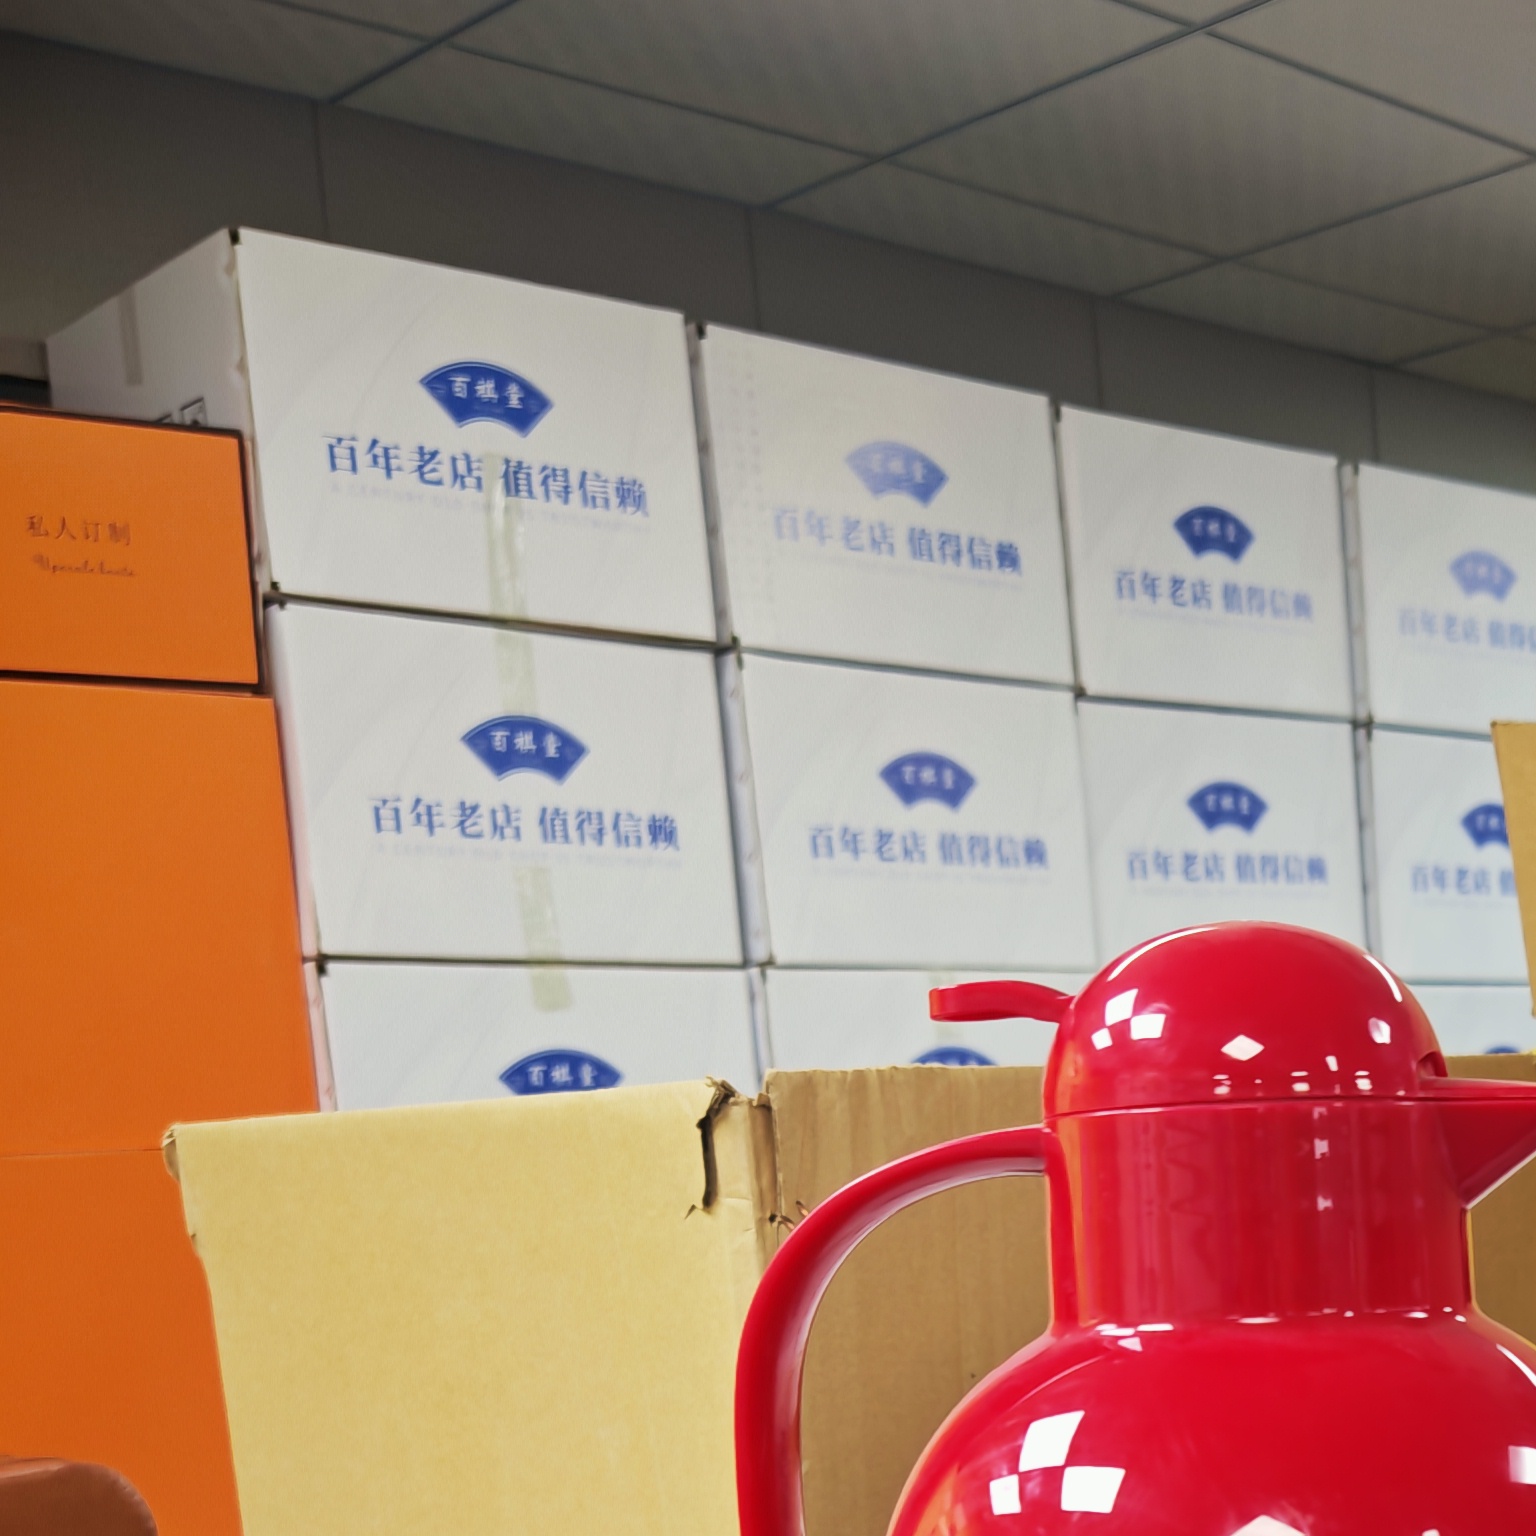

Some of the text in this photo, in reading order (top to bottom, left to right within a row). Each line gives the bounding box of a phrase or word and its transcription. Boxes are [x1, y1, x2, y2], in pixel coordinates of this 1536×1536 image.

[322, 435, 484, 493] 百年老店
[500, 456, 650, 518] 值得信赖
[368, 796, 680, 852] 百年老店 值得信赖
